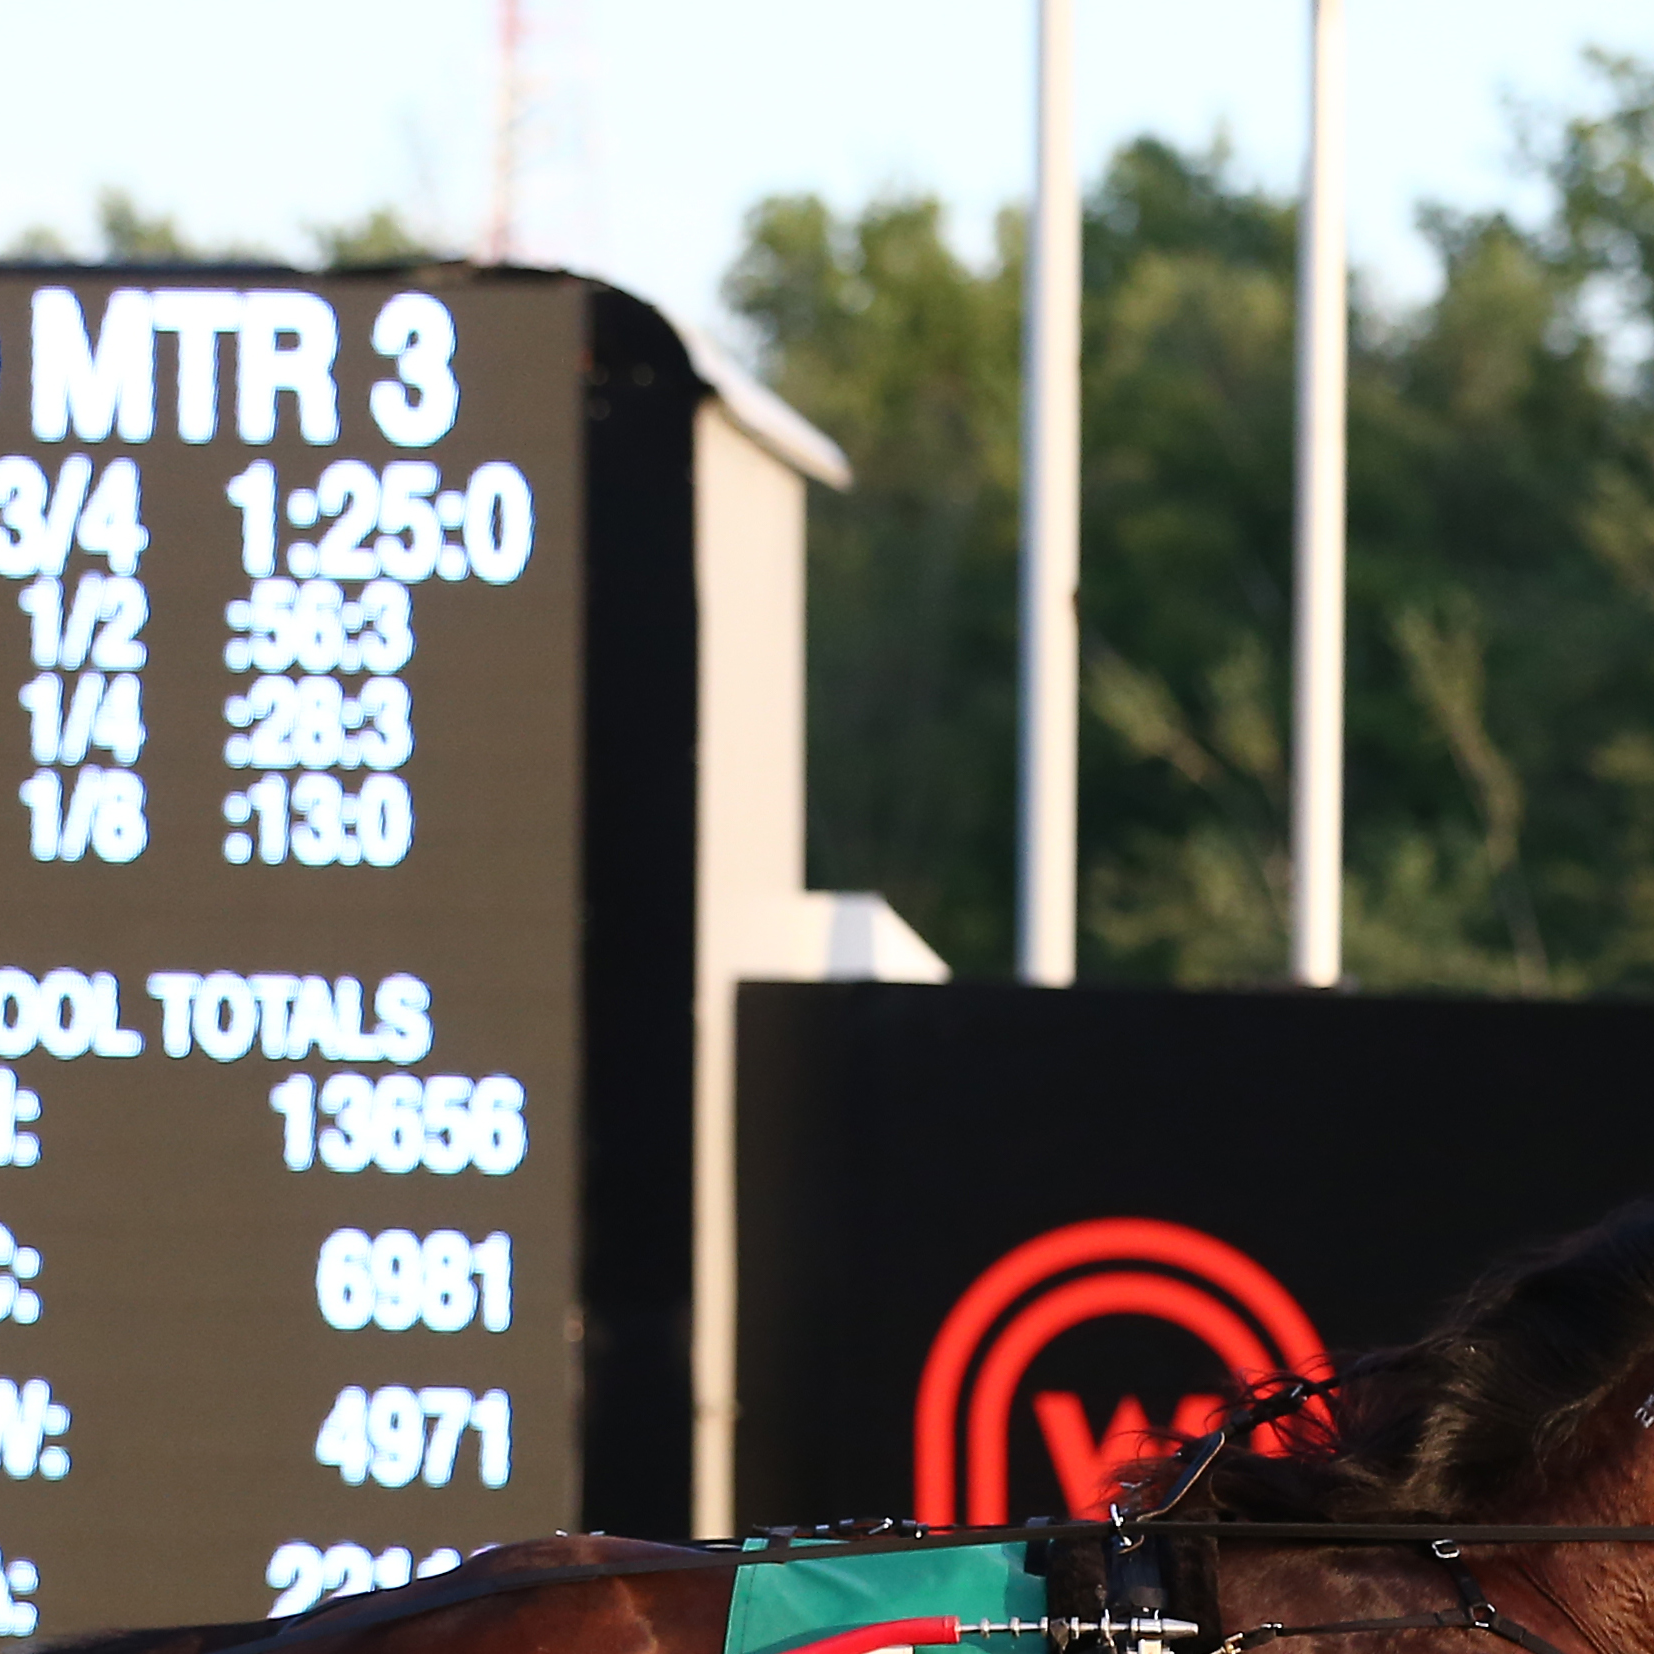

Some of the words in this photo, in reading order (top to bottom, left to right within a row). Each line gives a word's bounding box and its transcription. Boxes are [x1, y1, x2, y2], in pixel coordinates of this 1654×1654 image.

[30, 286, 339, 445] MTR
[370, 293, 459, 446] 3
[226, 459, 532, 584] 1:25:0
[18, 574, 148, 670] 1/2
[19, 671, 145, 766] 1/4
[19, 766, 147, 862] 1/8
[223, 772, 412, 866] :13:0
[146, 970, 432, 1065] TOTALS
[269, 1073, 526, 1174] 13656
[316, 1228, 510, 1331] 6981
[316, 1386, 509, 1487] 4971
